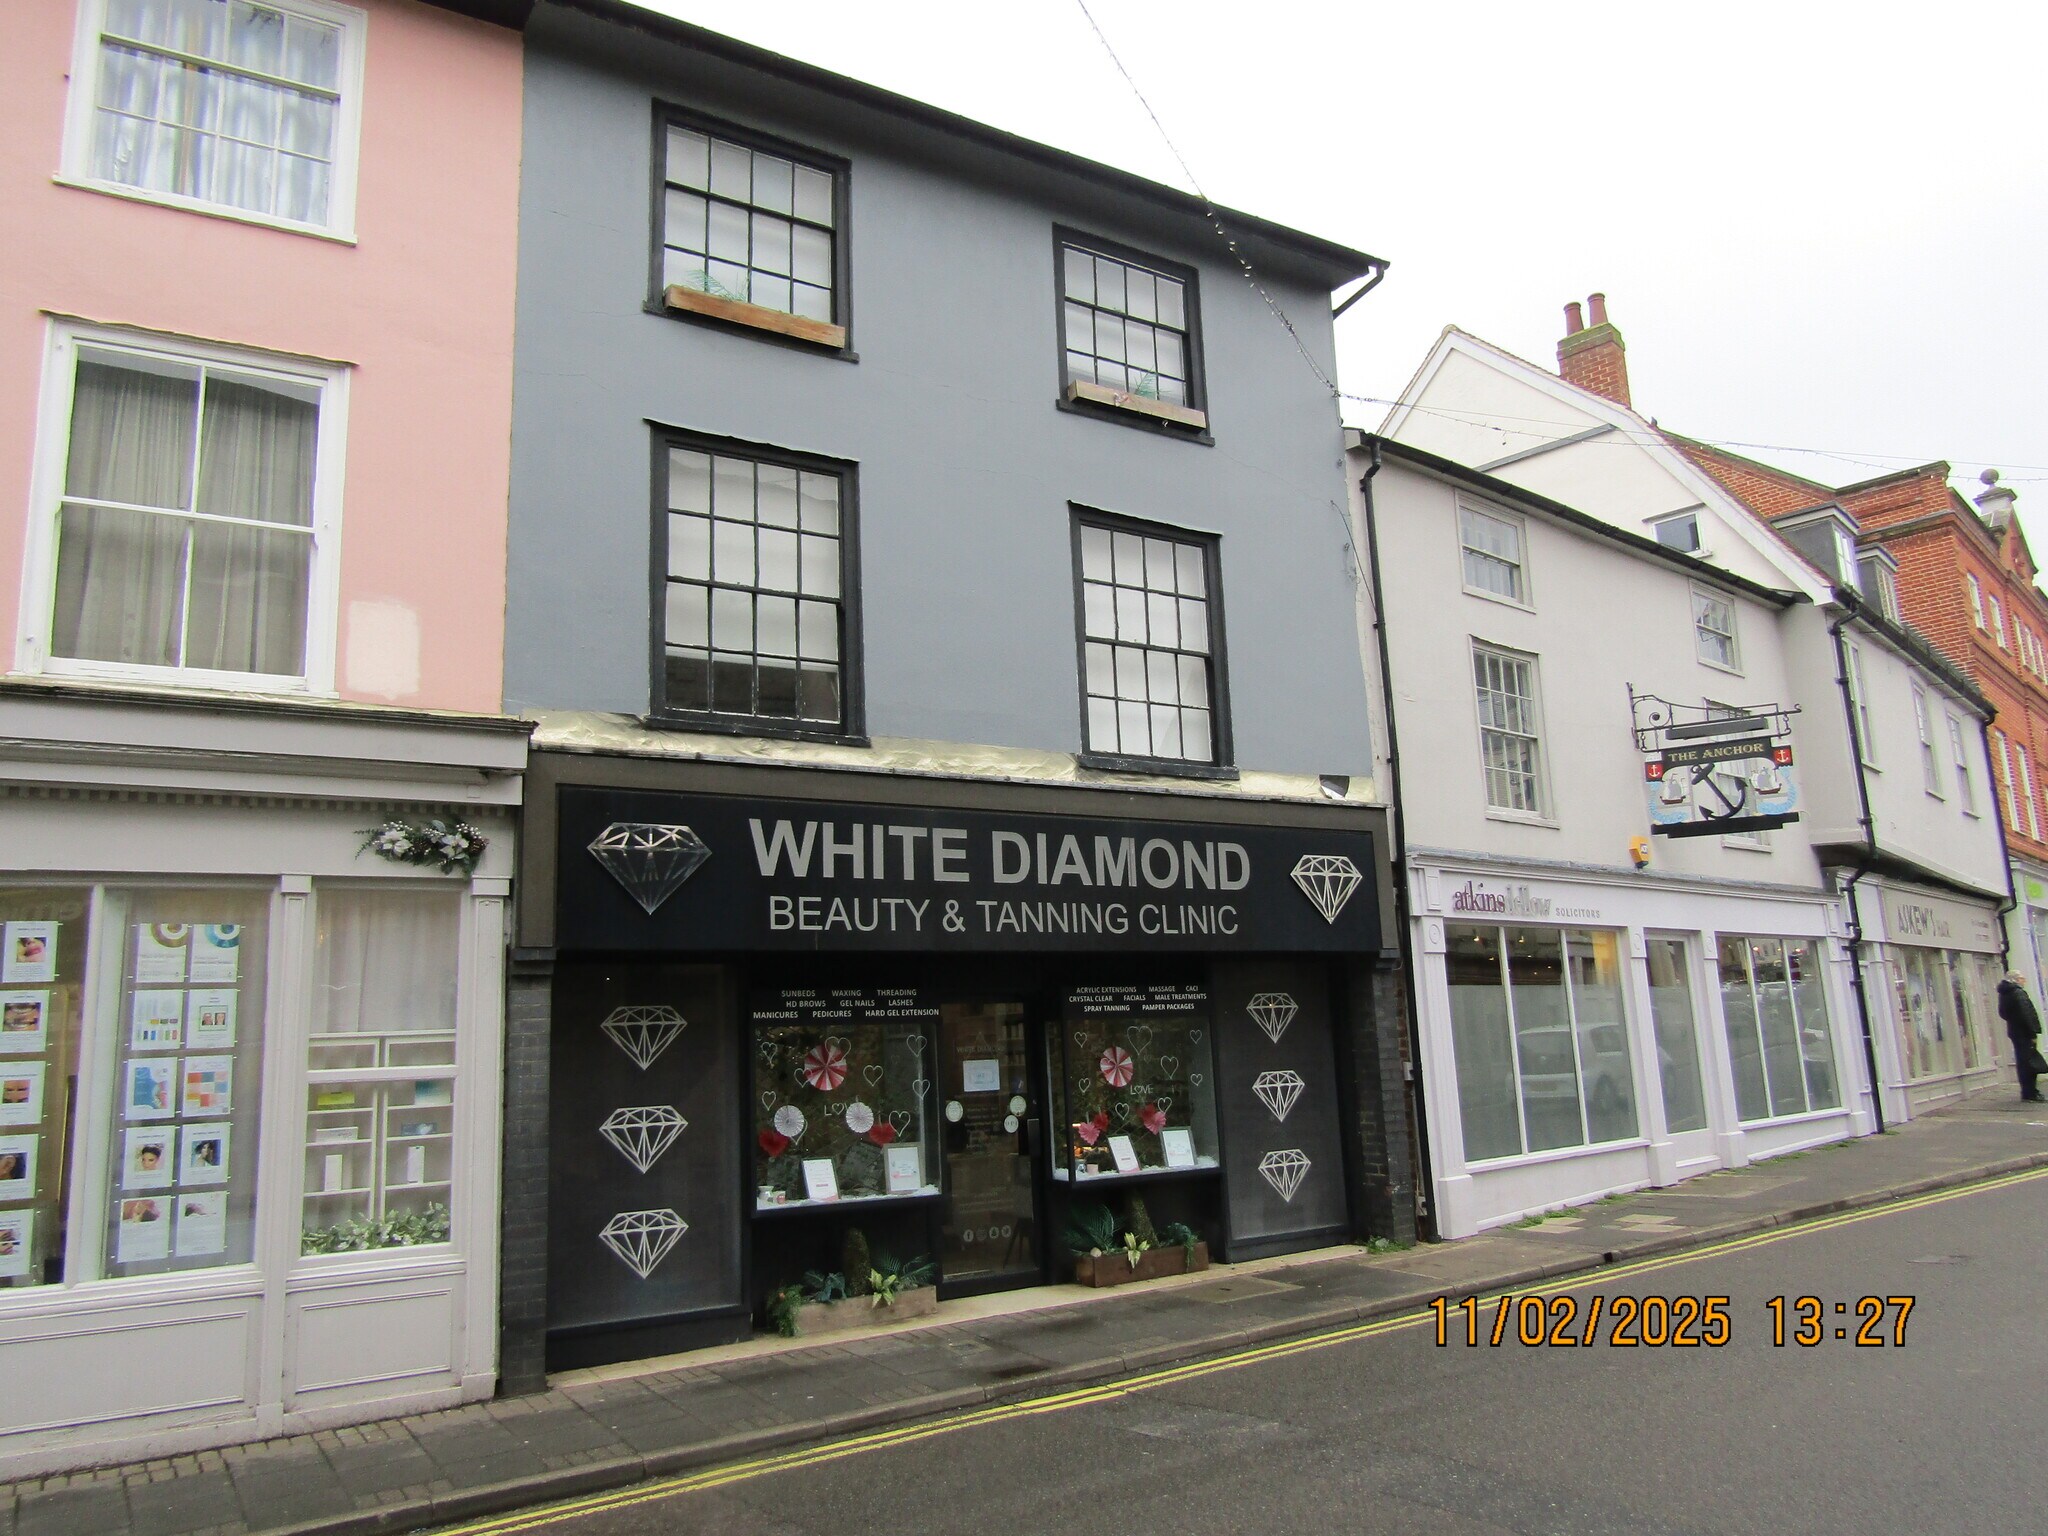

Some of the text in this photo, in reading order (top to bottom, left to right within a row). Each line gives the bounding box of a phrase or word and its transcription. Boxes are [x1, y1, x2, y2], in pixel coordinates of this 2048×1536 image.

[1668, 743, 1764, 762] THE ANCHOR
[748, 818, 1251, 891] WHITE DIAMOND
[769, 895, 1239, 934] BEAUTY & TANNING CLINIC
[1555, 907, 1601, 919] SOLICITORS
[781, 989, 917, 998] SUNBEDS WAXING THREADING
[1076, 986, 1100, 994] ACRYLIC
[1148, 985, 1176, 993] MASSAGE
[786, 999, 914, 1008] HD BROWS GEL NAILS LASHES
[1068, 995, 1093, 1003] CRYSTAL
[1103, 1004, 1130, 1012] TANNING
[753, 1008, 940, 1019] MANICURES PEDICURES HARD GEL EXTENSION
